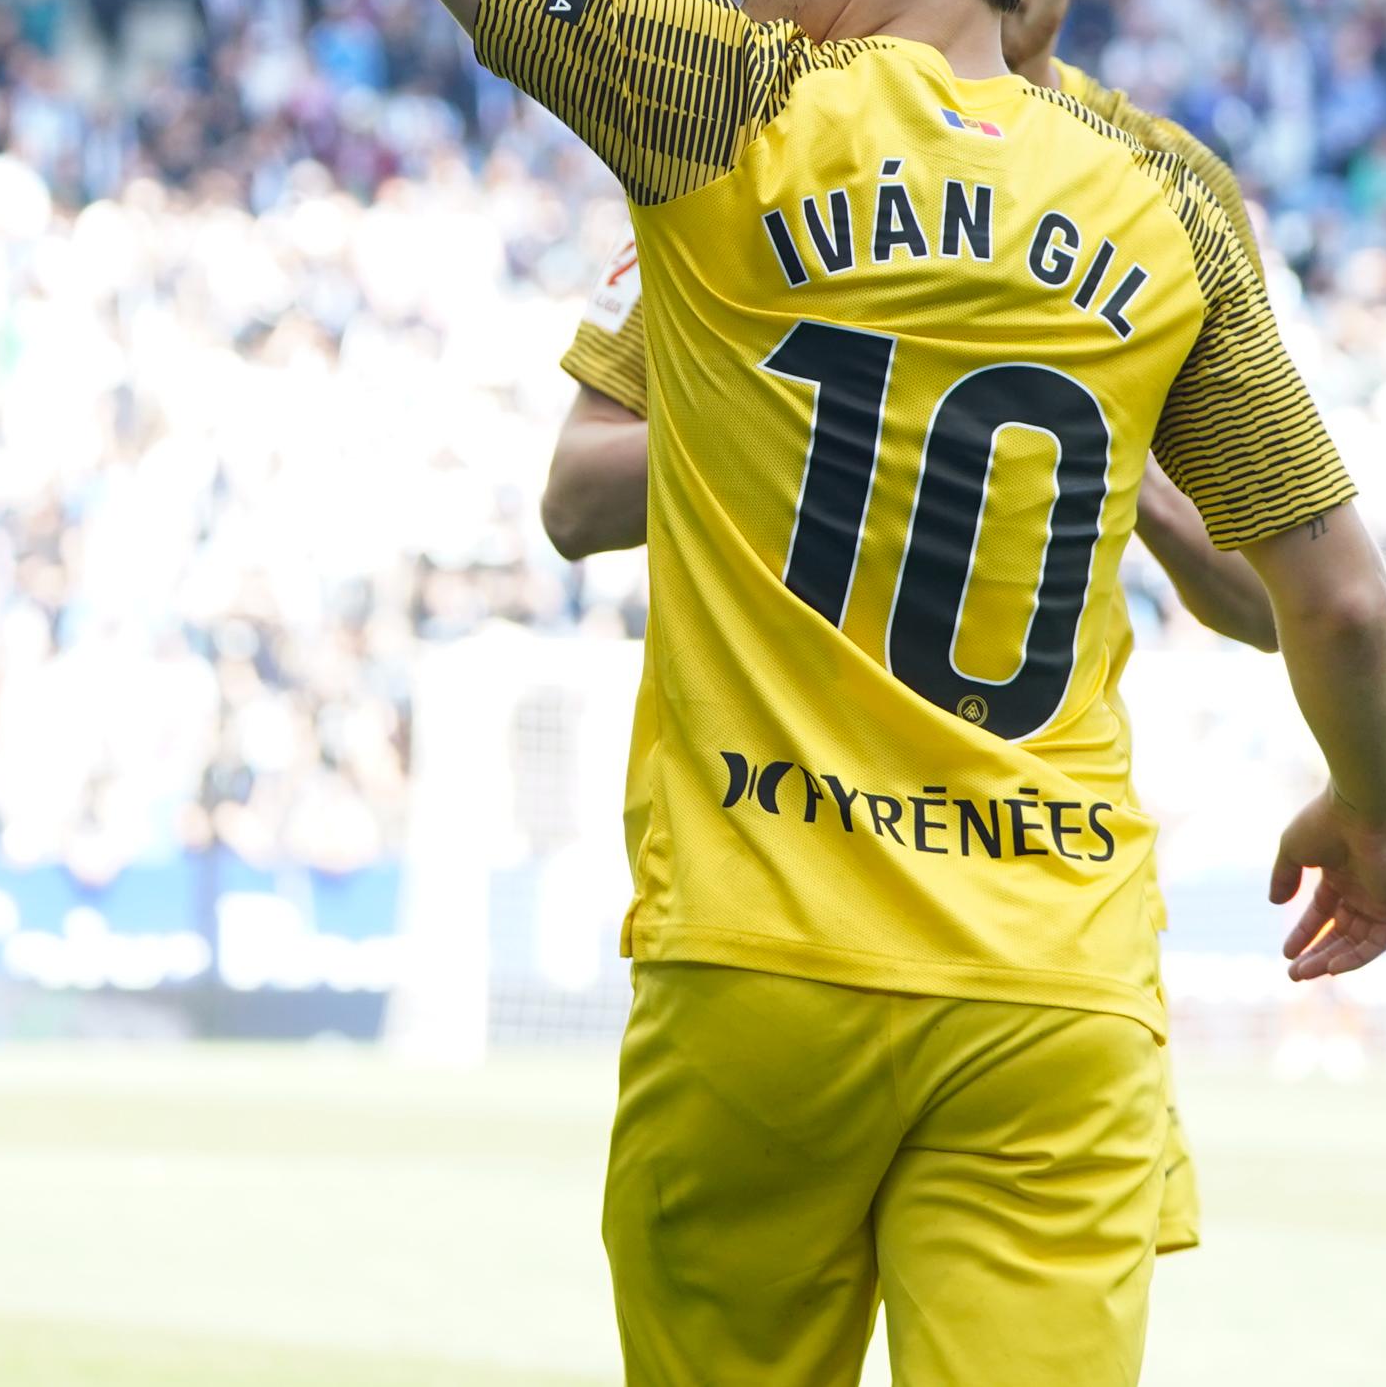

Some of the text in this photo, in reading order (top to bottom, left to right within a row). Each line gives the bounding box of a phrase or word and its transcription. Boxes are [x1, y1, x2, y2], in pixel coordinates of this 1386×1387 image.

[761, 157, 1150, 342] IVÁN GIL
[757, 320, 1112, 743] 10
